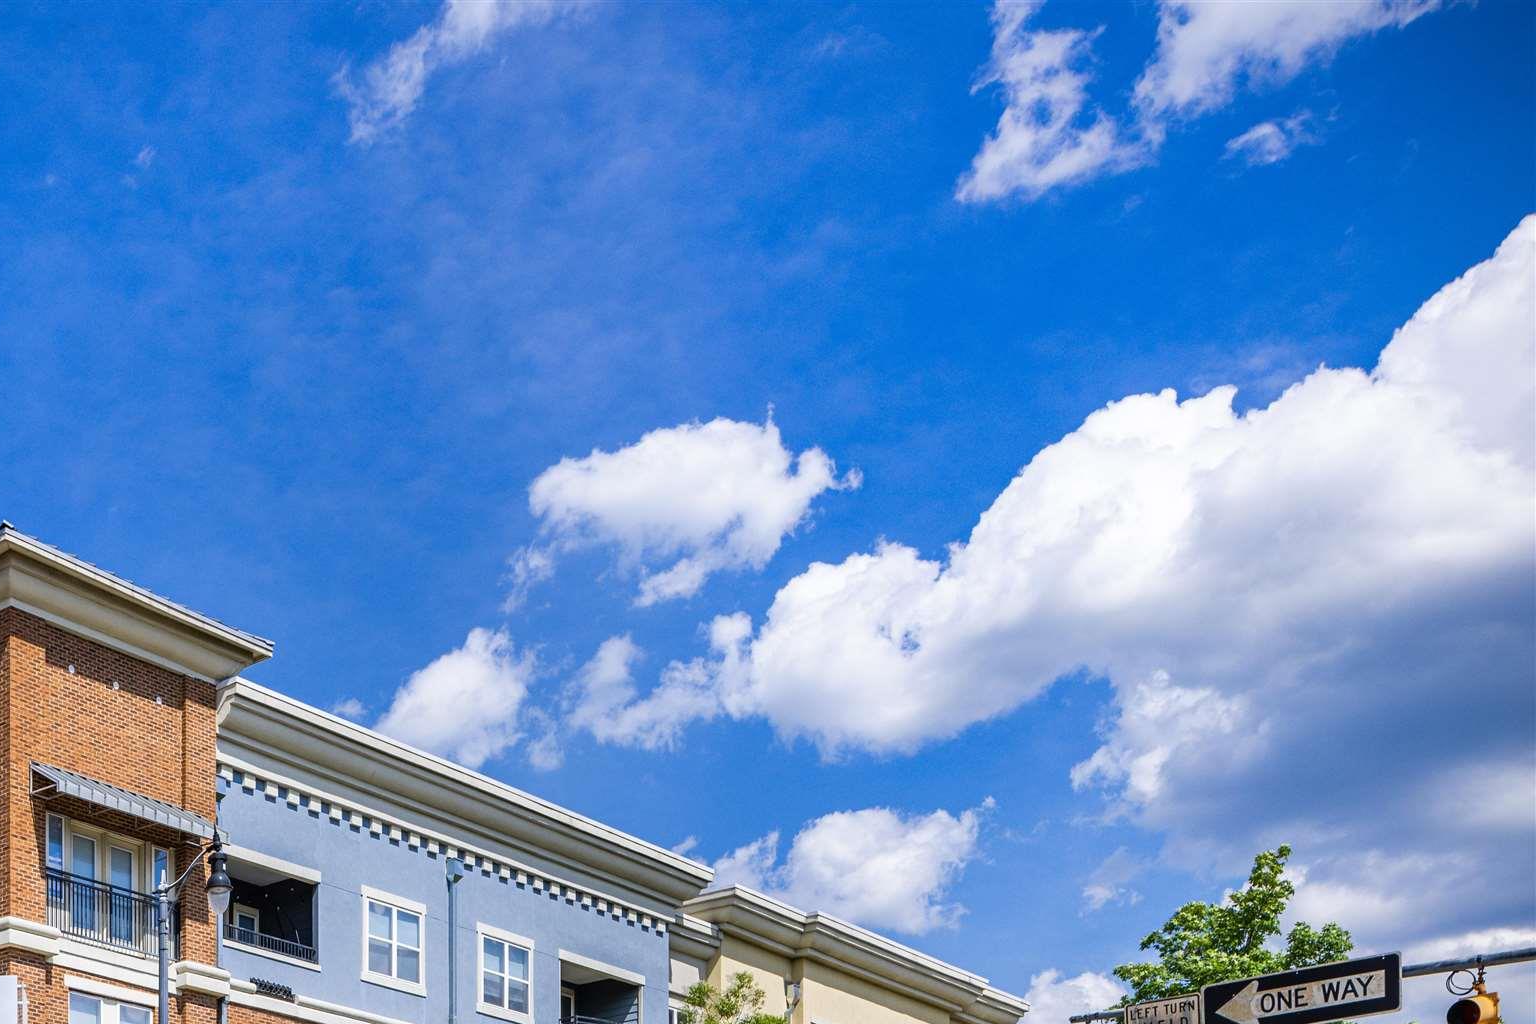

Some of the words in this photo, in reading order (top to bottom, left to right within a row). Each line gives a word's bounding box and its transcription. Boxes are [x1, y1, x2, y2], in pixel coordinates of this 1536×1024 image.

[1260, 987, 1308, 1013] ONE
[1321, 975, 1375, 1003] WAY
[1130, 1005, 1158, 1021] LEFT
[1164, 1000, 1195, 1015] TURN
